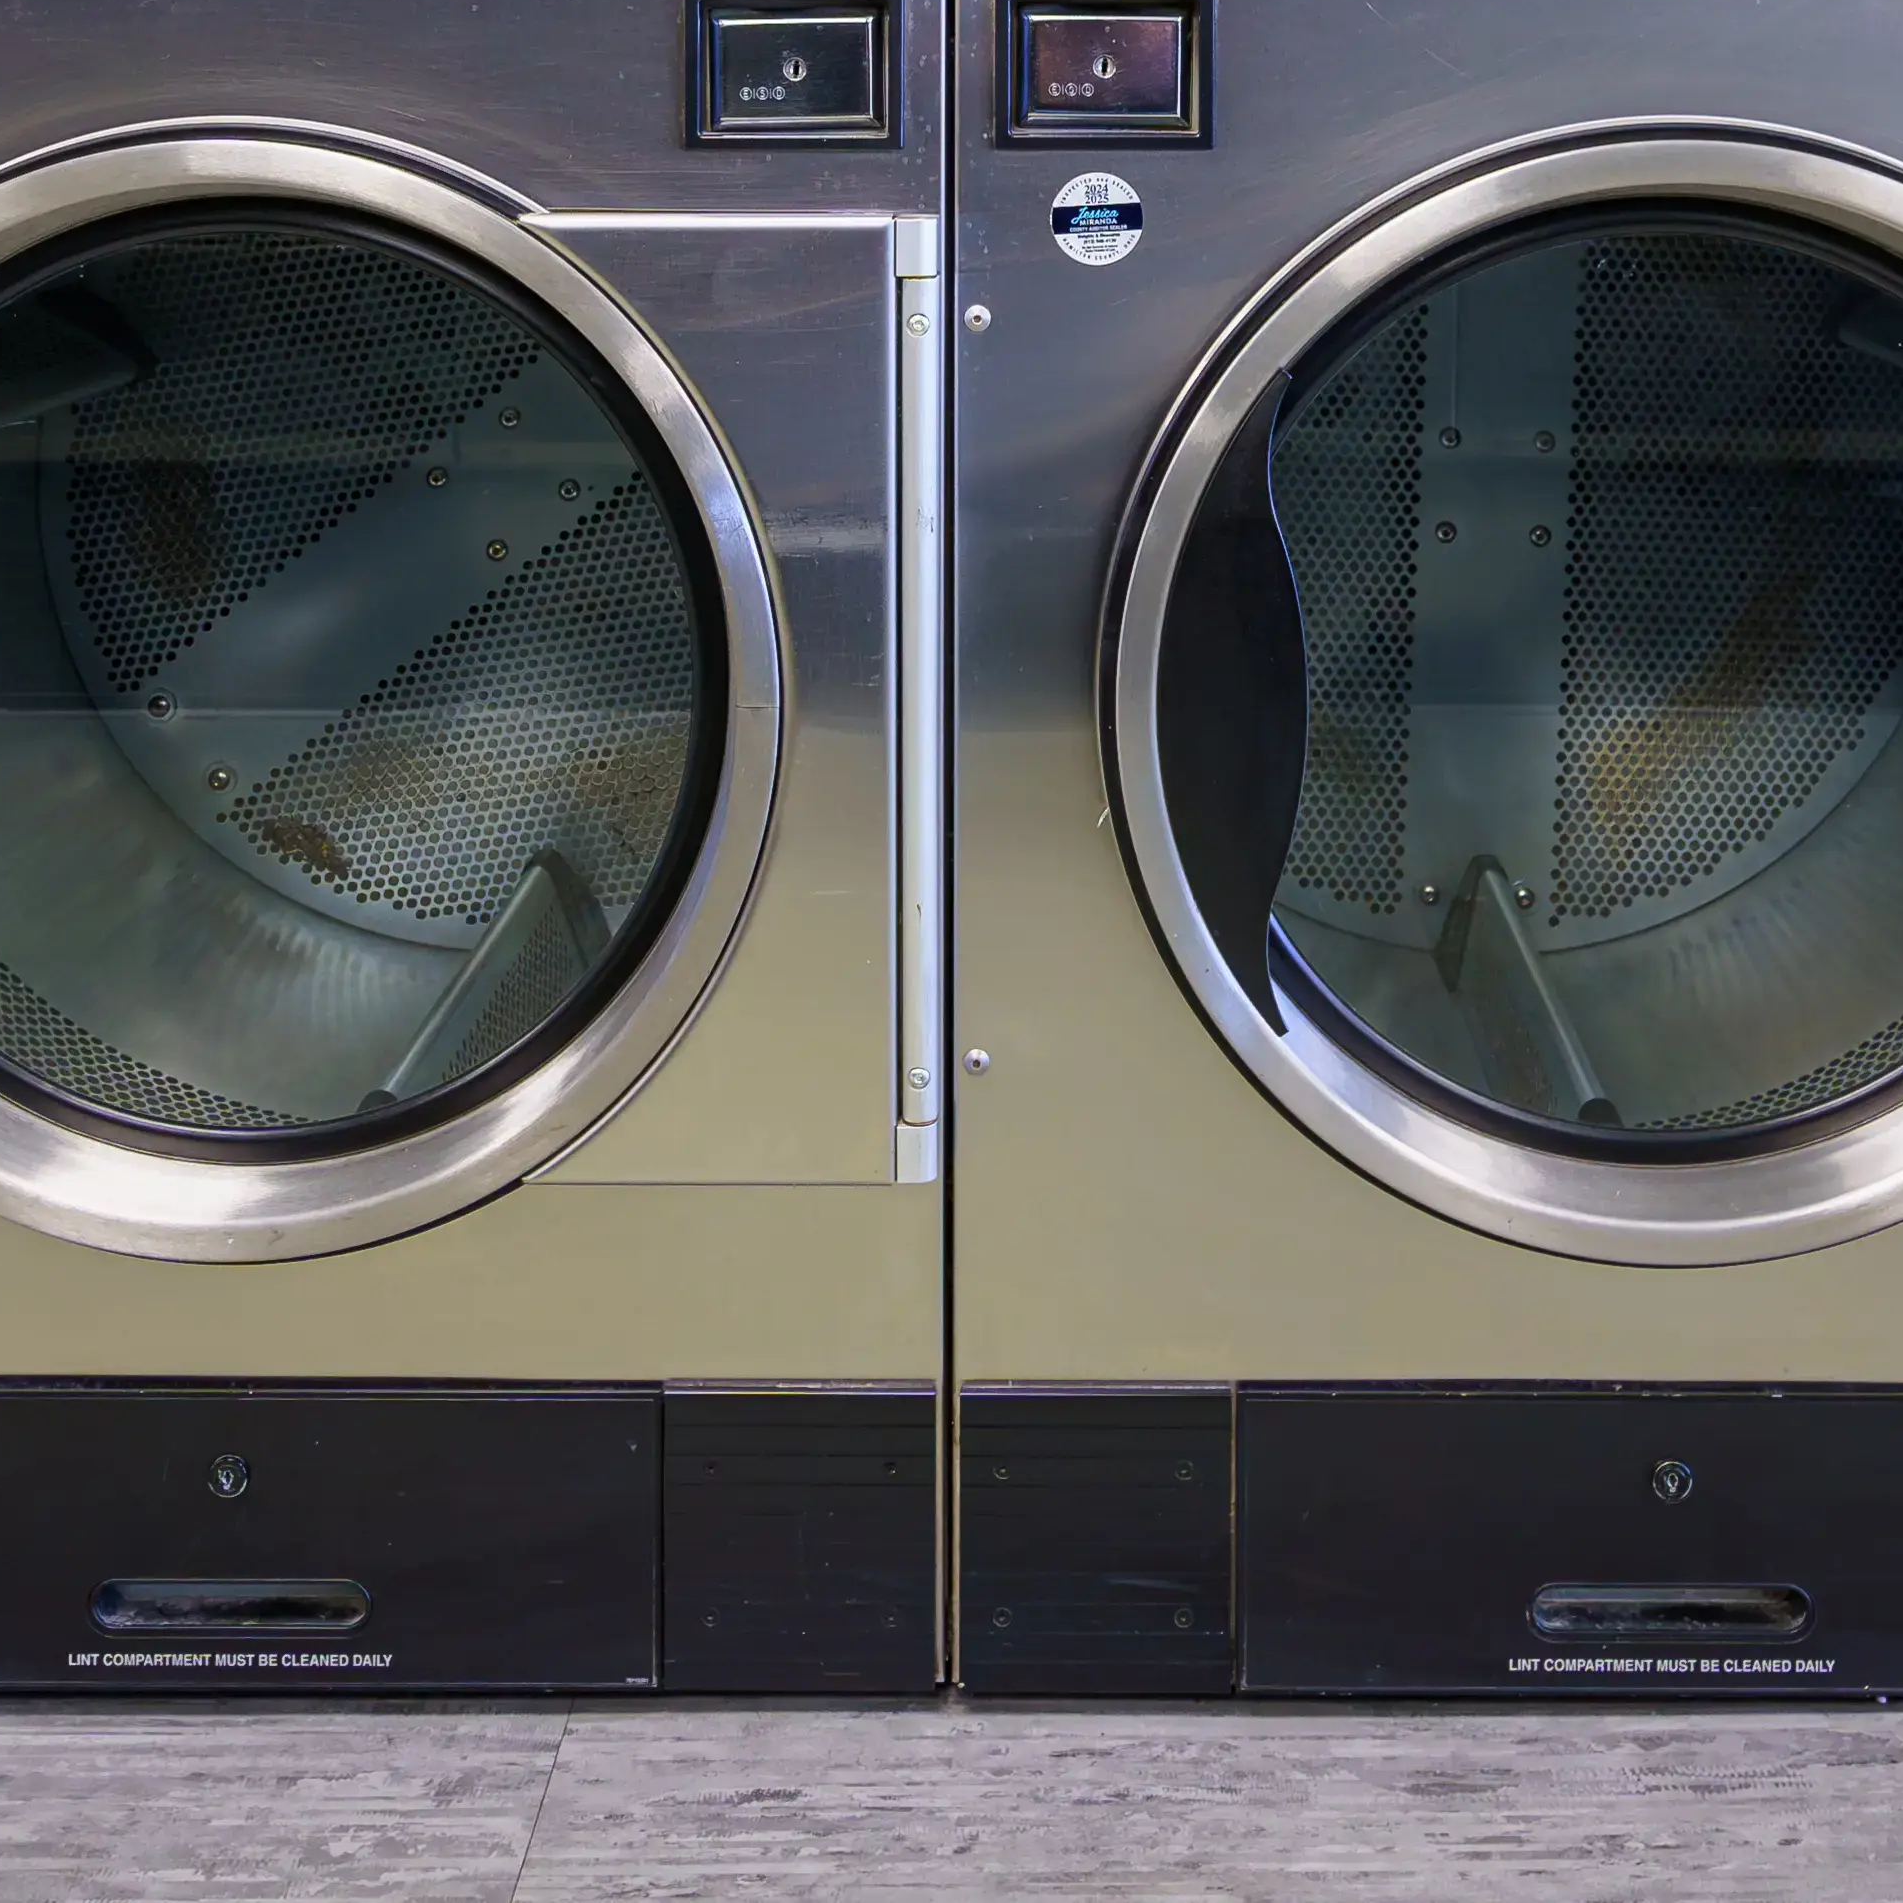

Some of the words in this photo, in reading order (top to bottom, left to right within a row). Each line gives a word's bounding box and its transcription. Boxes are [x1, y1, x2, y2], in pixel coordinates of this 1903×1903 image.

[1084, 185, 1109, 195] 2024
[1085, 194, 1109, 204] 2025
[1071, 207, 1119, 224] Jessica
[69, 1654, 99, 1666] LINT
[103, 1654, 211, 1666] COMPARTMENT
[215, 1654, 255, 1666] MUST
[259, 1654, 277, 1666] BE
[282, 1654, 349, 1666] CLEANED
[353, 1654, 392, 1667] DAILY
[1509, 1659, 1540, 1671] LINT
[1544, 1659, 1653, 1672] COMPARTMENT
[1657, 1659, 1696, 1672] MUST
[1701, 1660, 1719, 1672] BE
[1724, 1659, 1791, 1672] CLEANED
[1796, 1660, 1835, 1672] DAILY
